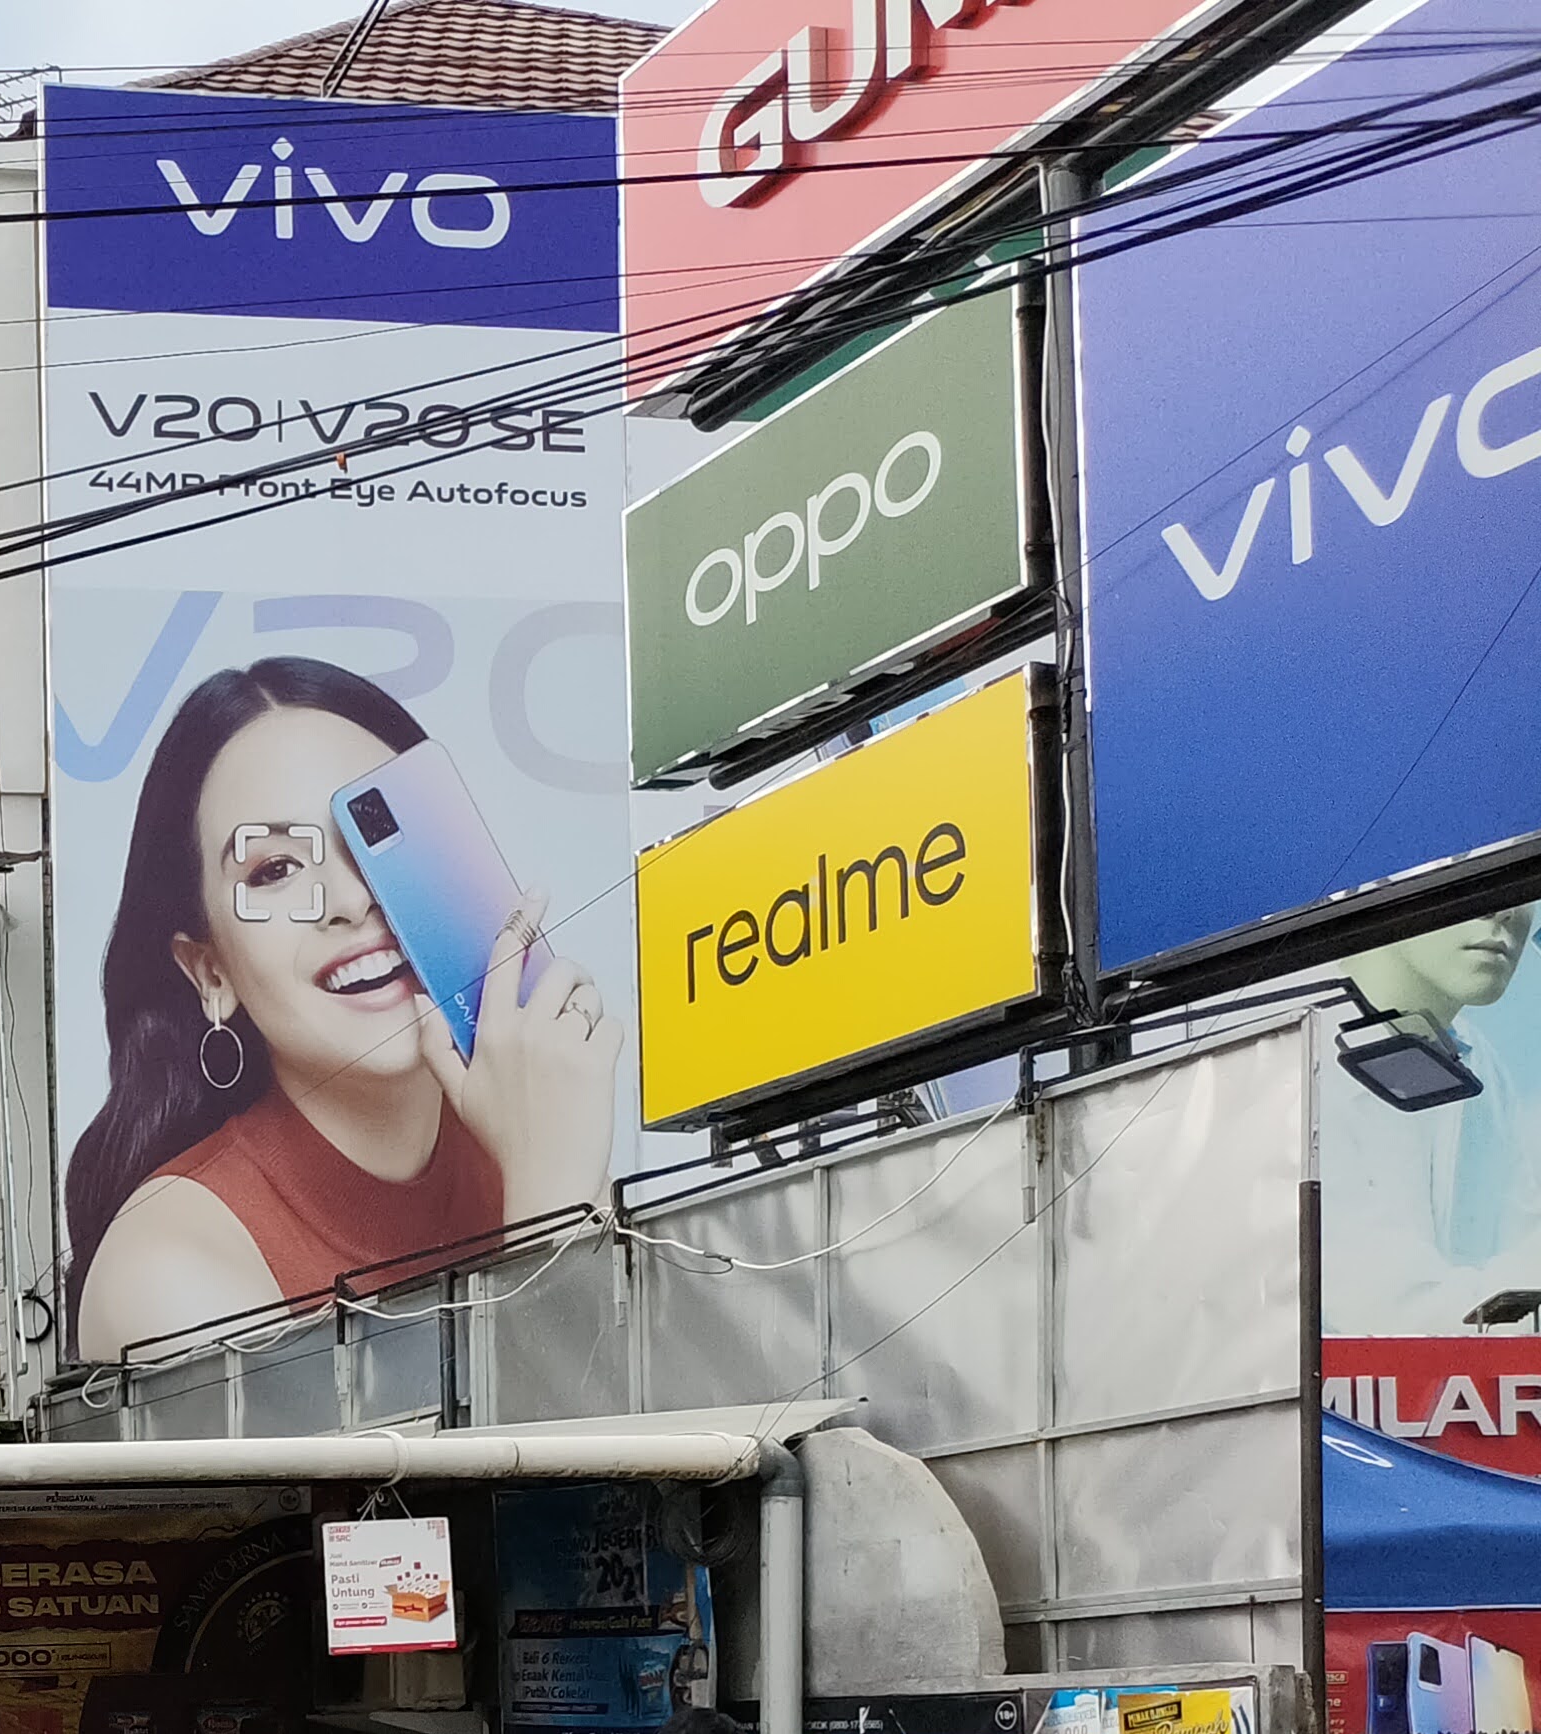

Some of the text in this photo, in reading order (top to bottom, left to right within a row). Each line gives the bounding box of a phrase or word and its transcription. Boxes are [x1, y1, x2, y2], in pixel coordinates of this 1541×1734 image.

[156, 136, 511, 249] vivo
[89, 391, 587, 454] V20 V20 SE
[329, 478, 395, 508] Eye
[406, 479, 588, 508] Autofocus
[684, 430, 942, 627] oppo
[684, 821, 967, 1004] realme
[331, 1573, 360, 1585] Pasti
[331, 1587, 375, 1599] Untung
[7, 1592, 161, 1618] SATUAN
